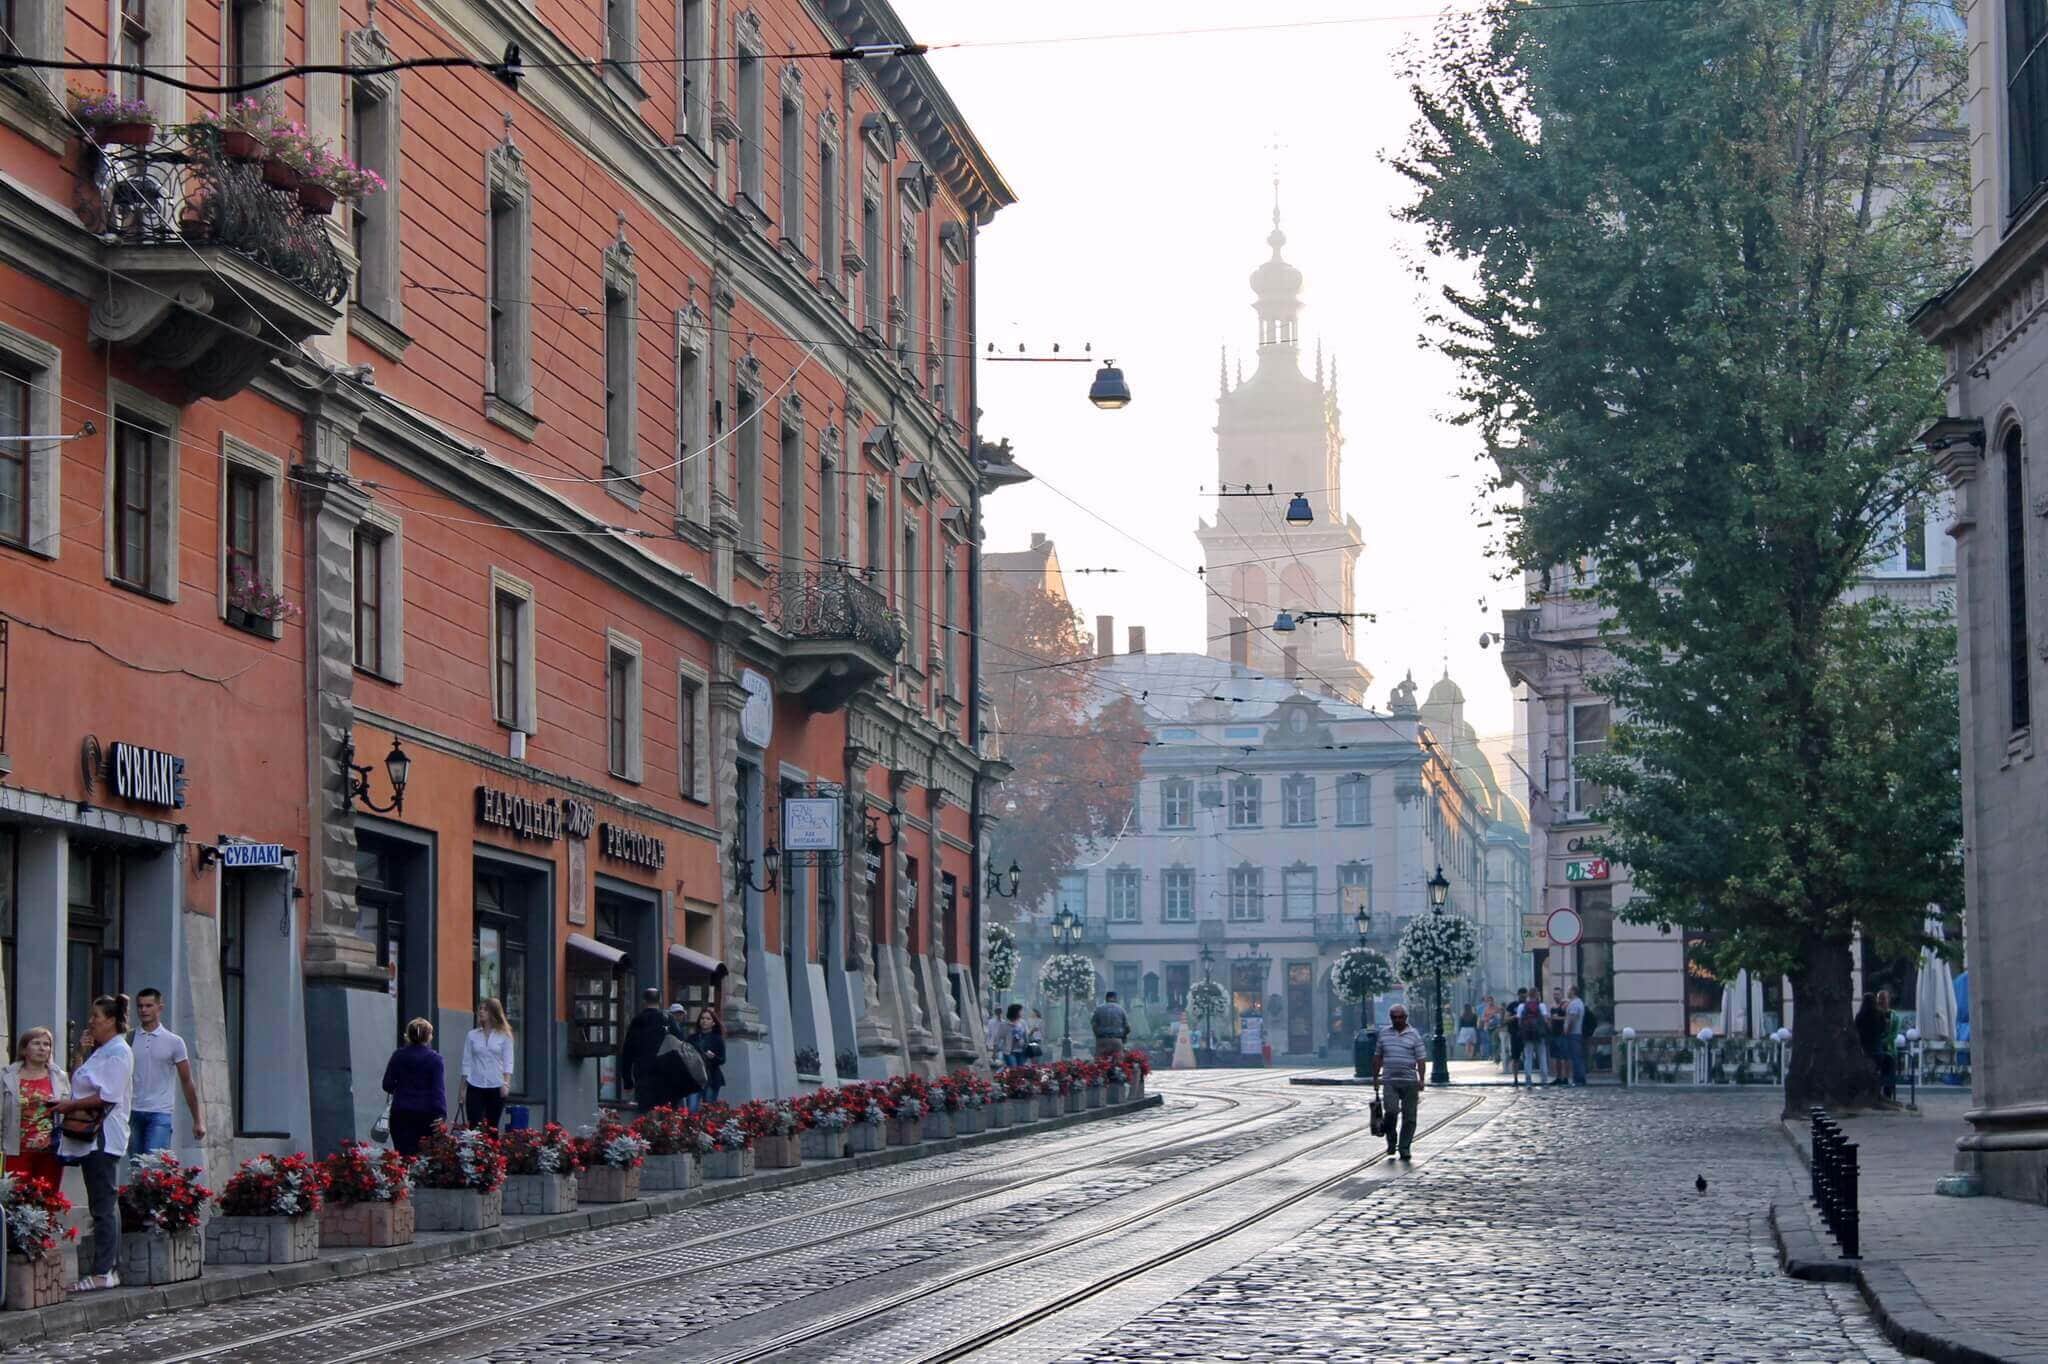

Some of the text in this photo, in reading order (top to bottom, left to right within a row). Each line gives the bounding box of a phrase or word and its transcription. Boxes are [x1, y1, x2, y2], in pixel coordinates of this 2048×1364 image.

[116, 743, 175, 805] СУВЛАКІ
[226, 845, 279, 864] СУВЛАКІ
[484, 786, 562, 840] НАРОДНИЙ
[607, 823, 665, 870] РЕСТОРАН
